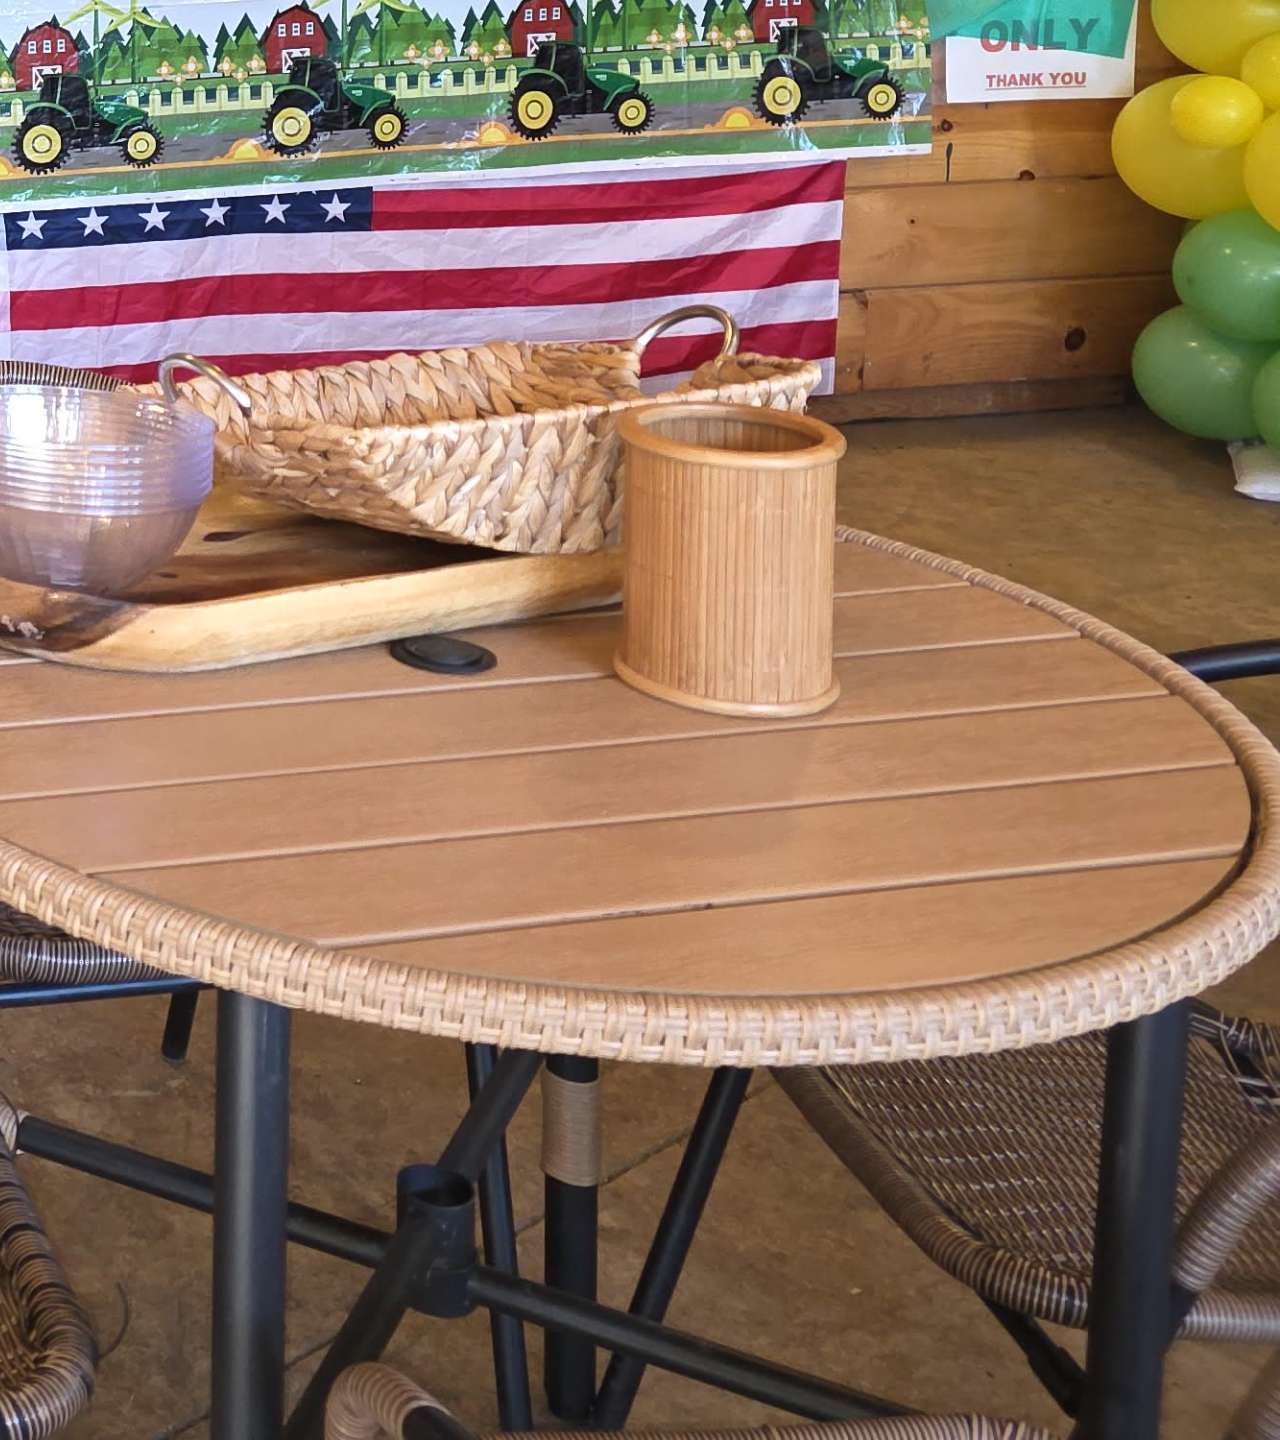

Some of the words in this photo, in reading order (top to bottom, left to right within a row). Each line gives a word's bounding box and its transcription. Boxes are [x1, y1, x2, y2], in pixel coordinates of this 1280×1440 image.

[979, 17, 1101, 53] ONLY
[986, 73, 1044, 88] THANK
[1049, 72, 1087, 86] YOU
